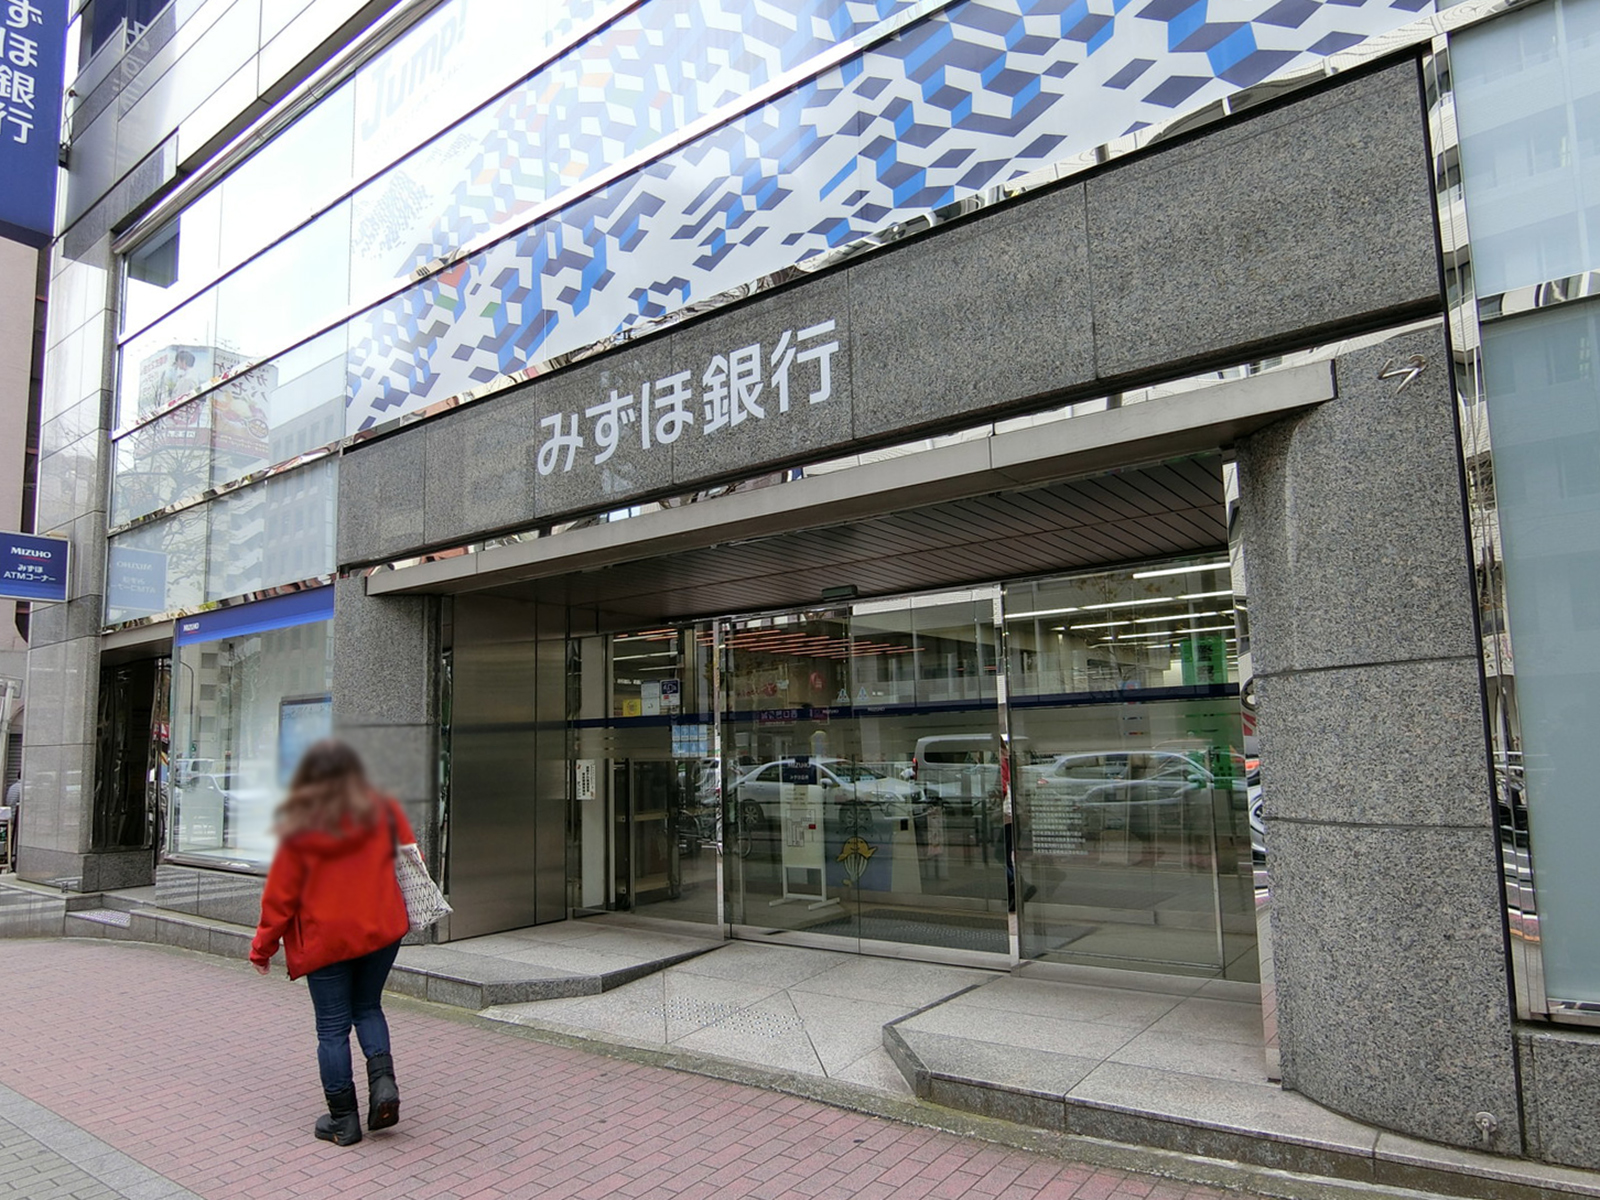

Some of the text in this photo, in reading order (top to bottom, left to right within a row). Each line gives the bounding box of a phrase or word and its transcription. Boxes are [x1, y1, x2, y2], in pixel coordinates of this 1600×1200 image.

[361, 0, 468, 142] Jump!
[536, 319, 839, 476] みずほ銀行
[10, 546, 52, 559] MIZUHO
[17, 563, 44, 574] みずほ
[3, 570, 57, 583] ATMコーナー
